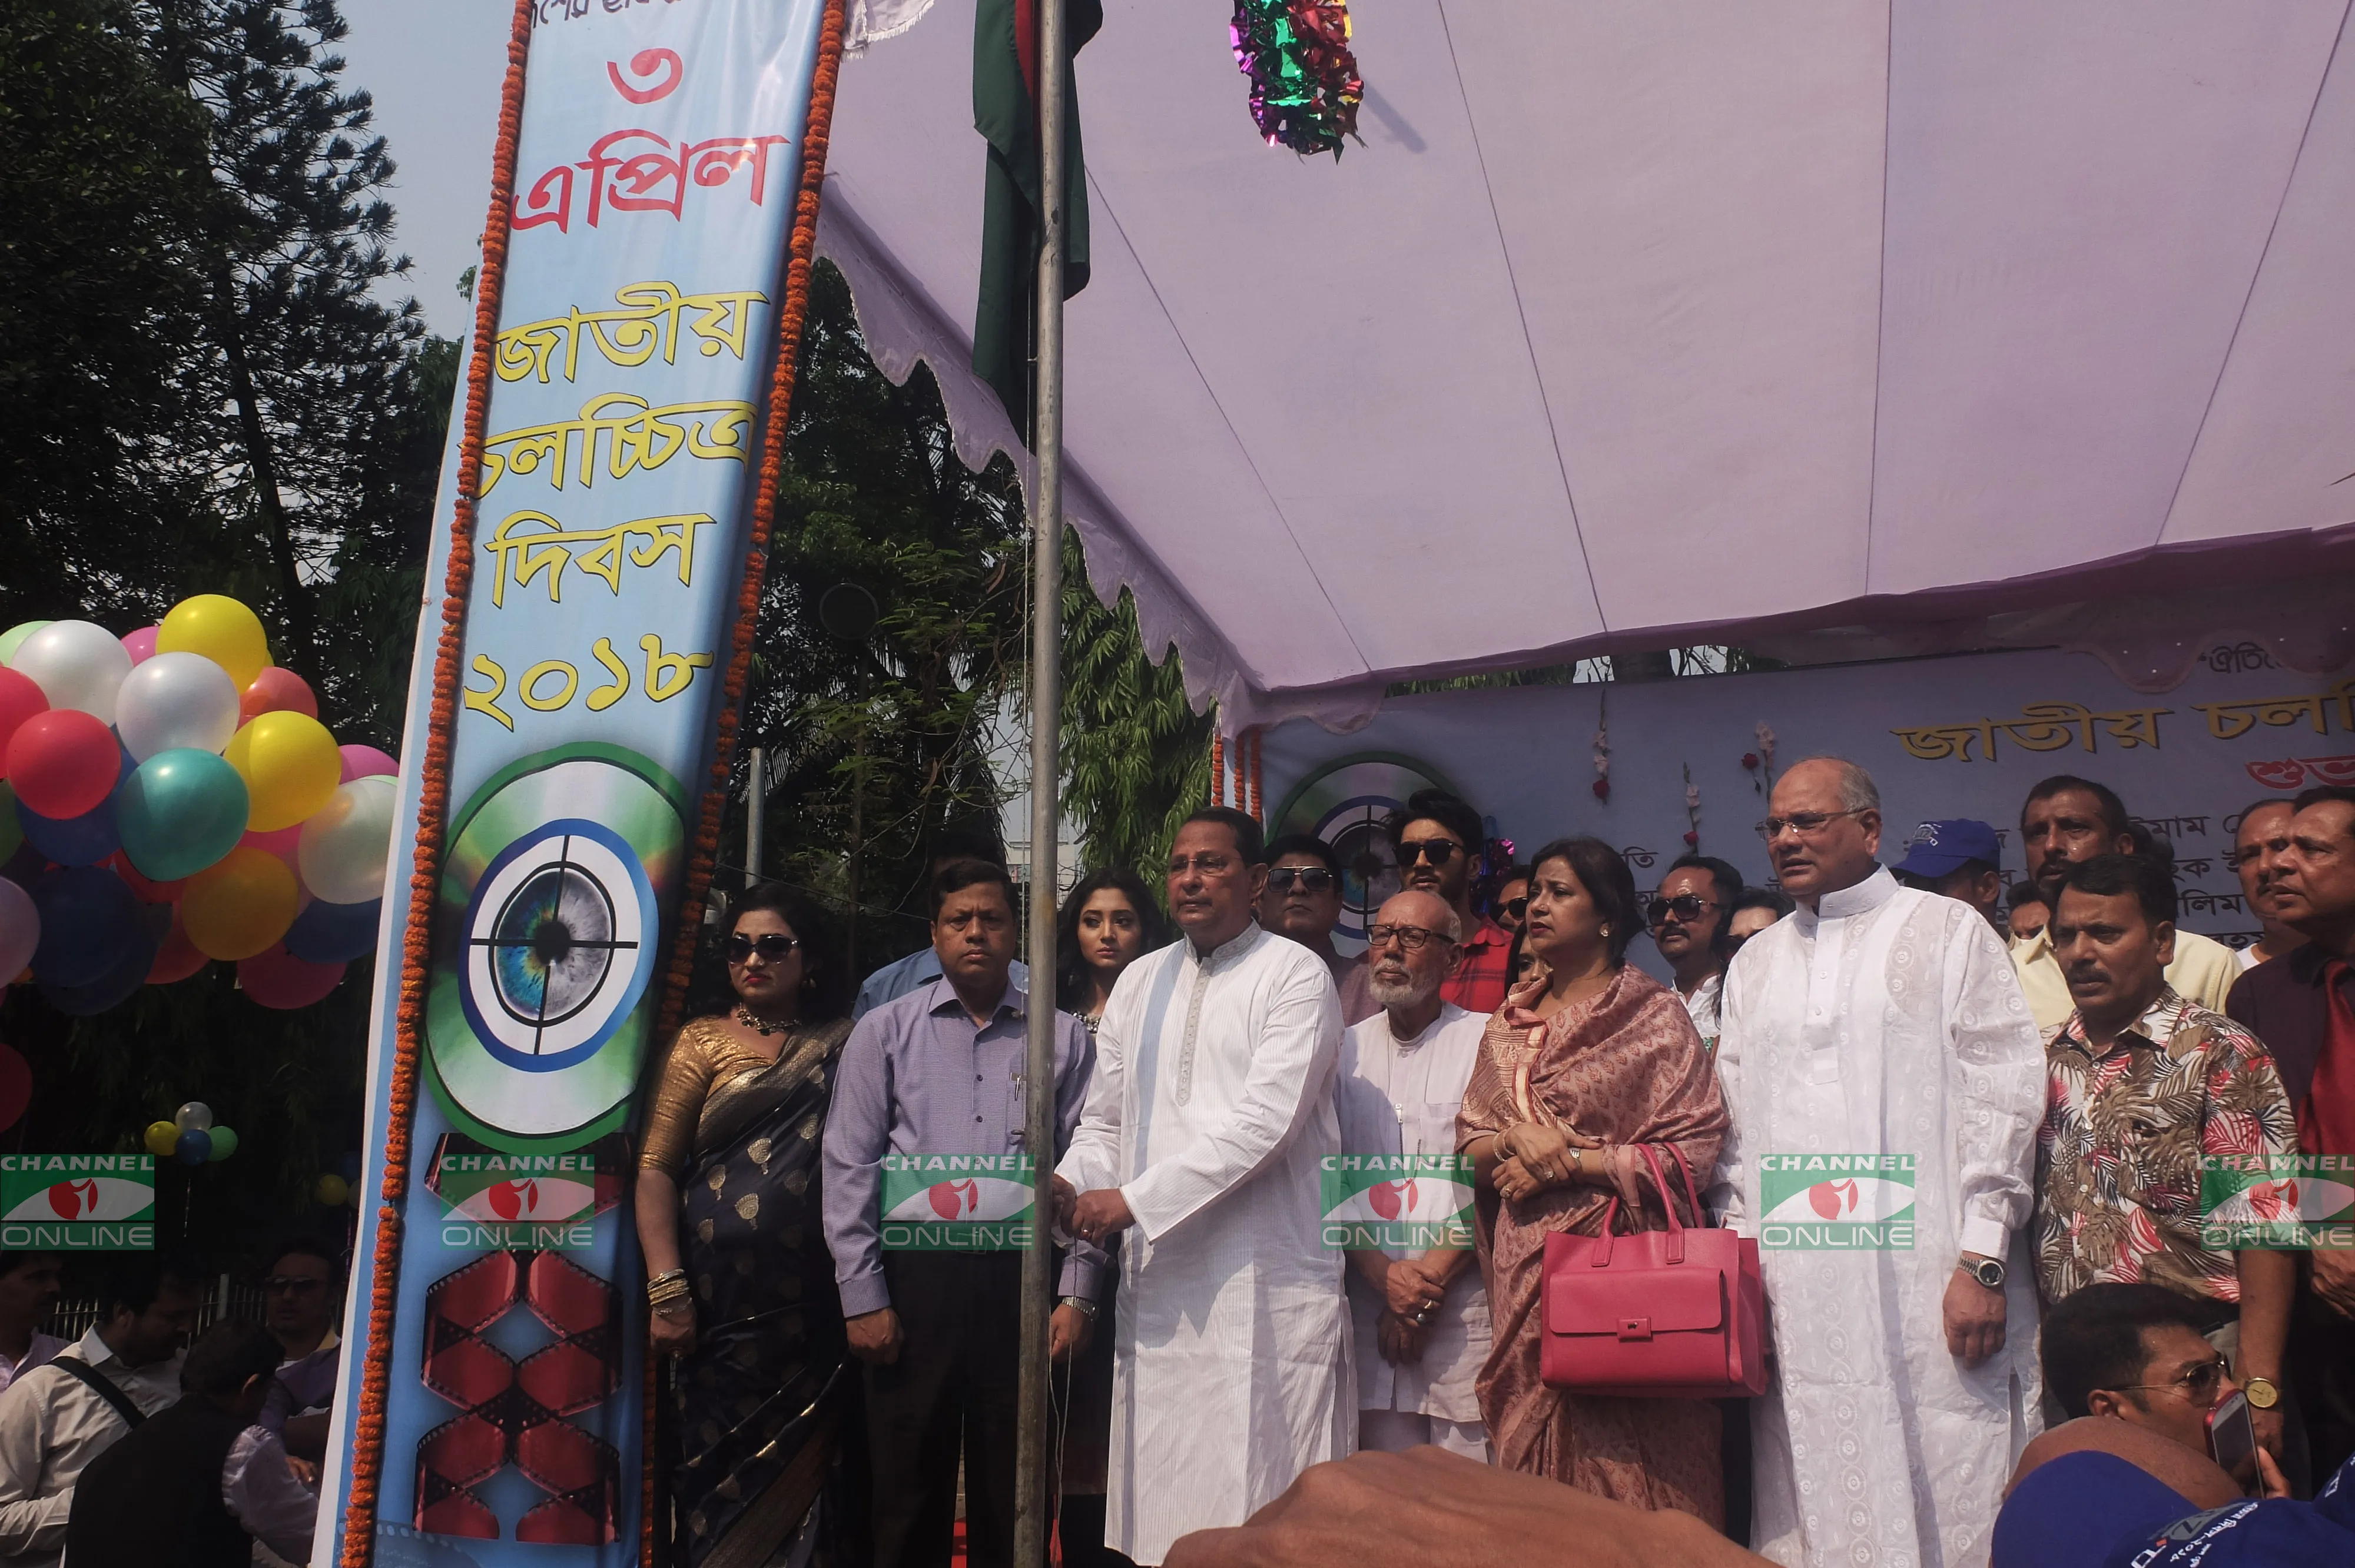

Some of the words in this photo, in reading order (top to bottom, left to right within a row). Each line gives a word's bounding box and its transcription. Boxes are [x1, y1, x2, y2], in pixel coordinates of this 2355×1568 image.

[606, 47, 683, 105] ৩
[510, 128, 791, 234] এপ্রিল
[491, 280, 771, 384] জাতীয়
[483, 509, 718, 610] দিবস
[462, 633, 714, 733] ২০১৮
[1890, 700, 2175, 763] জাতীয়
